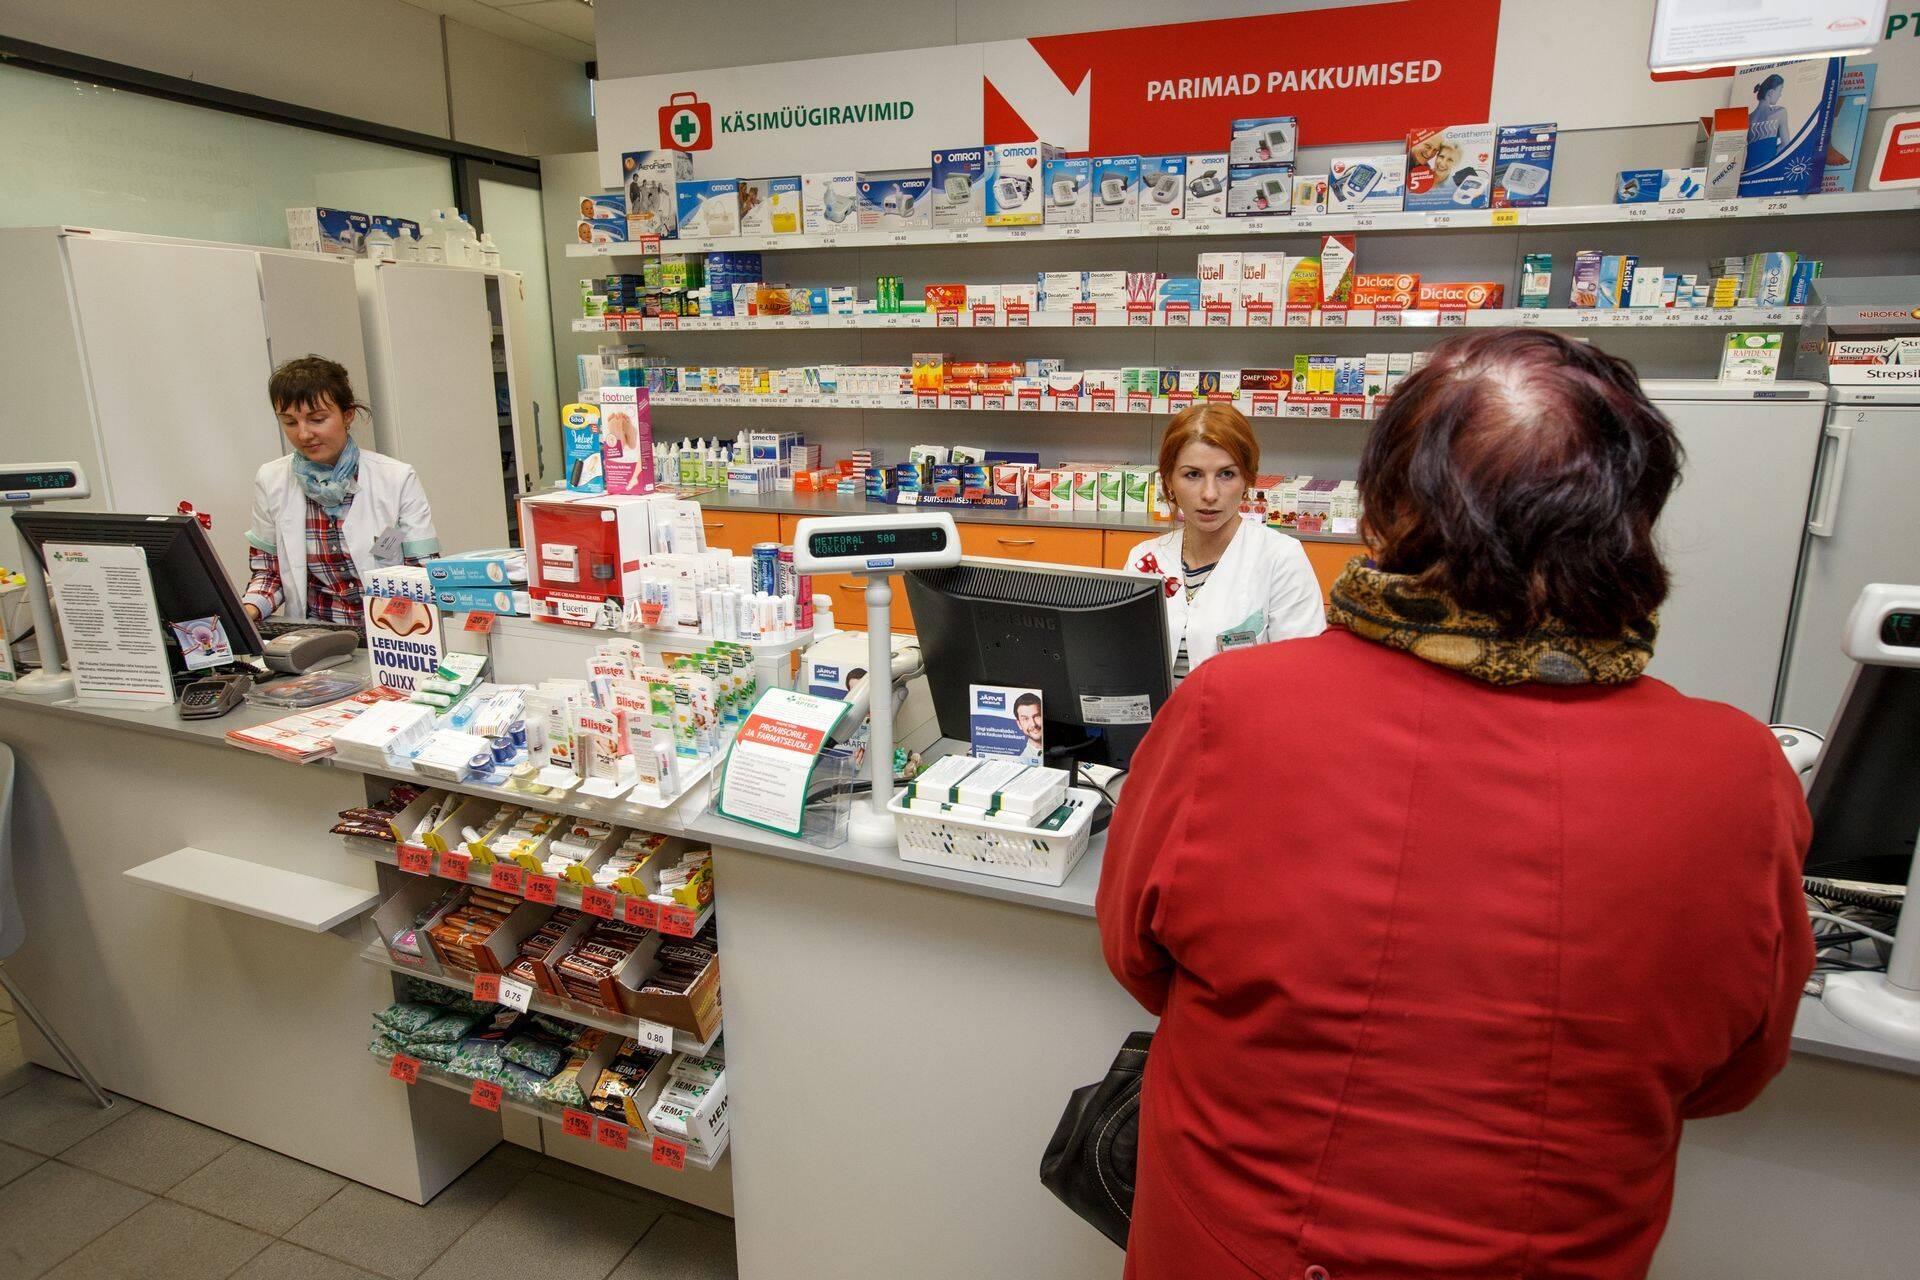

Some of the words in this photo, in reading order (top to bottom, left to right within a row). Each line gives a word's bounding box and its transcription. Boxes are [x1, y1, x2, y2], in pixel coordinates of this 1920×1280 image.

[1147, 73, 1260, 102] PARIMAD
[1267, 59, 1442, 93] PAKKUMISED
[721, 101, 914, 133] KÄSIMÜÜGIRAVIMID
[1446, 130, 1492, 139] Geratherm
[1003, 147, 1037, 157] OMRON
[1521, 144, 1551, 152] Pressure
[948, 151, 981, 162] OMRON
[1712, 157, 1737, 185] PRELOX
[1357, 276, 1394, 287] Diclac
[1622, 259, 1634, 292] Excilor
[1763, 268, 1780, 305] Zyrtec
[1793, 275, 1805, 304] Claritine
[1354, 294, 1392, 304] Diclac
[1420, 288, 1463, 300] Diclac
[1733, 349, 1774, 357] RAPIDENT
[1839, 345, 1889, 355] Strepsils
[1342, 362, 1350, 384] QUIXX
[1357, 362, 1365, 384] QUIXX
[602, 392, 634, 402] footner
[571, 430, 593, 443] Velvet
[729, 472, 752, 481] microlax
[815, 536, 864, 546] METFORAL
[877, 534, 896, 543] 500
[931, 532, 938, 540] 5
[815, 545, 847, 554] KOKKU
[562, 603, 588, 613] Eucerin
[470, 616, 488, 625] -20%
[372, 636, 437, 656] LEEVENDUS
[373, 650, 438, 673] NOHULE
[594, 667, 624, 677] Blistex
[379, 670, 415, 690] QUIXX
[616, 697, 645, 710] Blistex
[979, 694, 1003, 702] JÄRVE
[581, 718, 612, 734] Blistex
[760, 723, 808, 741] PROVIISORILE
[745, 728, 755, 738] JA
[757, 731, 813, 750] FARMATSEUDILE
[407, 854, 427, 865] -15%
[444, 859, 464, 870] -15%
[496, 871, 517, 884] -15%
[530, 882, 552, 894] -15%
[587, 897, 611, 909] -15%
[629, 907, 653, 918] -15%
[505, 990, 521, 1002] 0.75
[647, 1032, 664, 1043] 0.80
[477, 1088, 496, 1100] -20%
[566, 1118, 588, 1130] -15%
[601, 1130, 623, 1141] -15%
[657, 1147, 680, 1160] -15%
